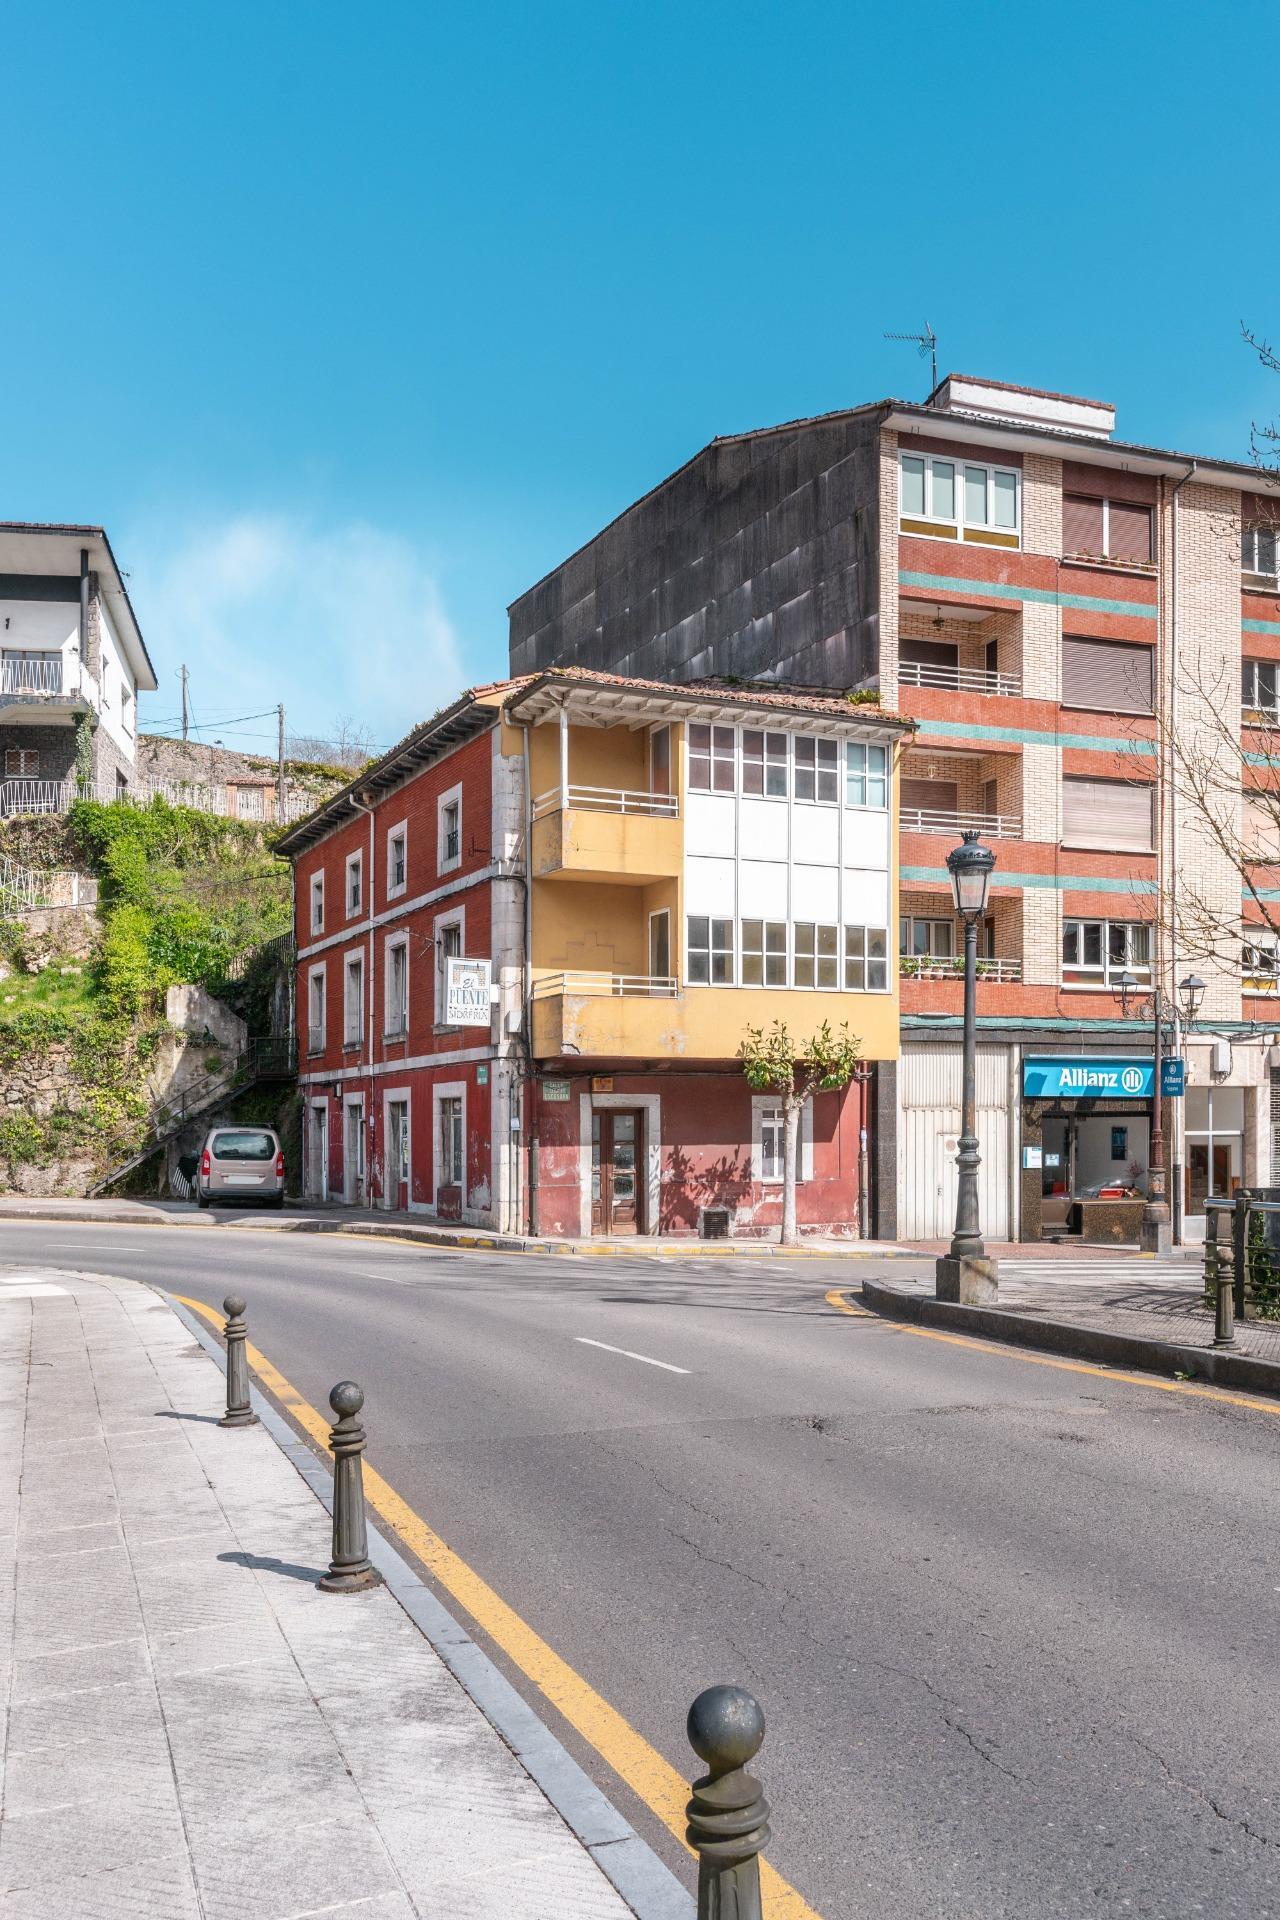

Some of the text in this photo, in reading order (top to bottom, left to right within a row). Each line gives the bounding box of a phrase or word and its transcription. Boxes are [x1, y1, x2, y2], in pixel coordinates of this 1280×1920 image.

[449, 989, 489, 1006] PUENTE
[1059, 1068, 1118, 1087] Allianz
[1163, 1076, 1182, 1084] Allianz
